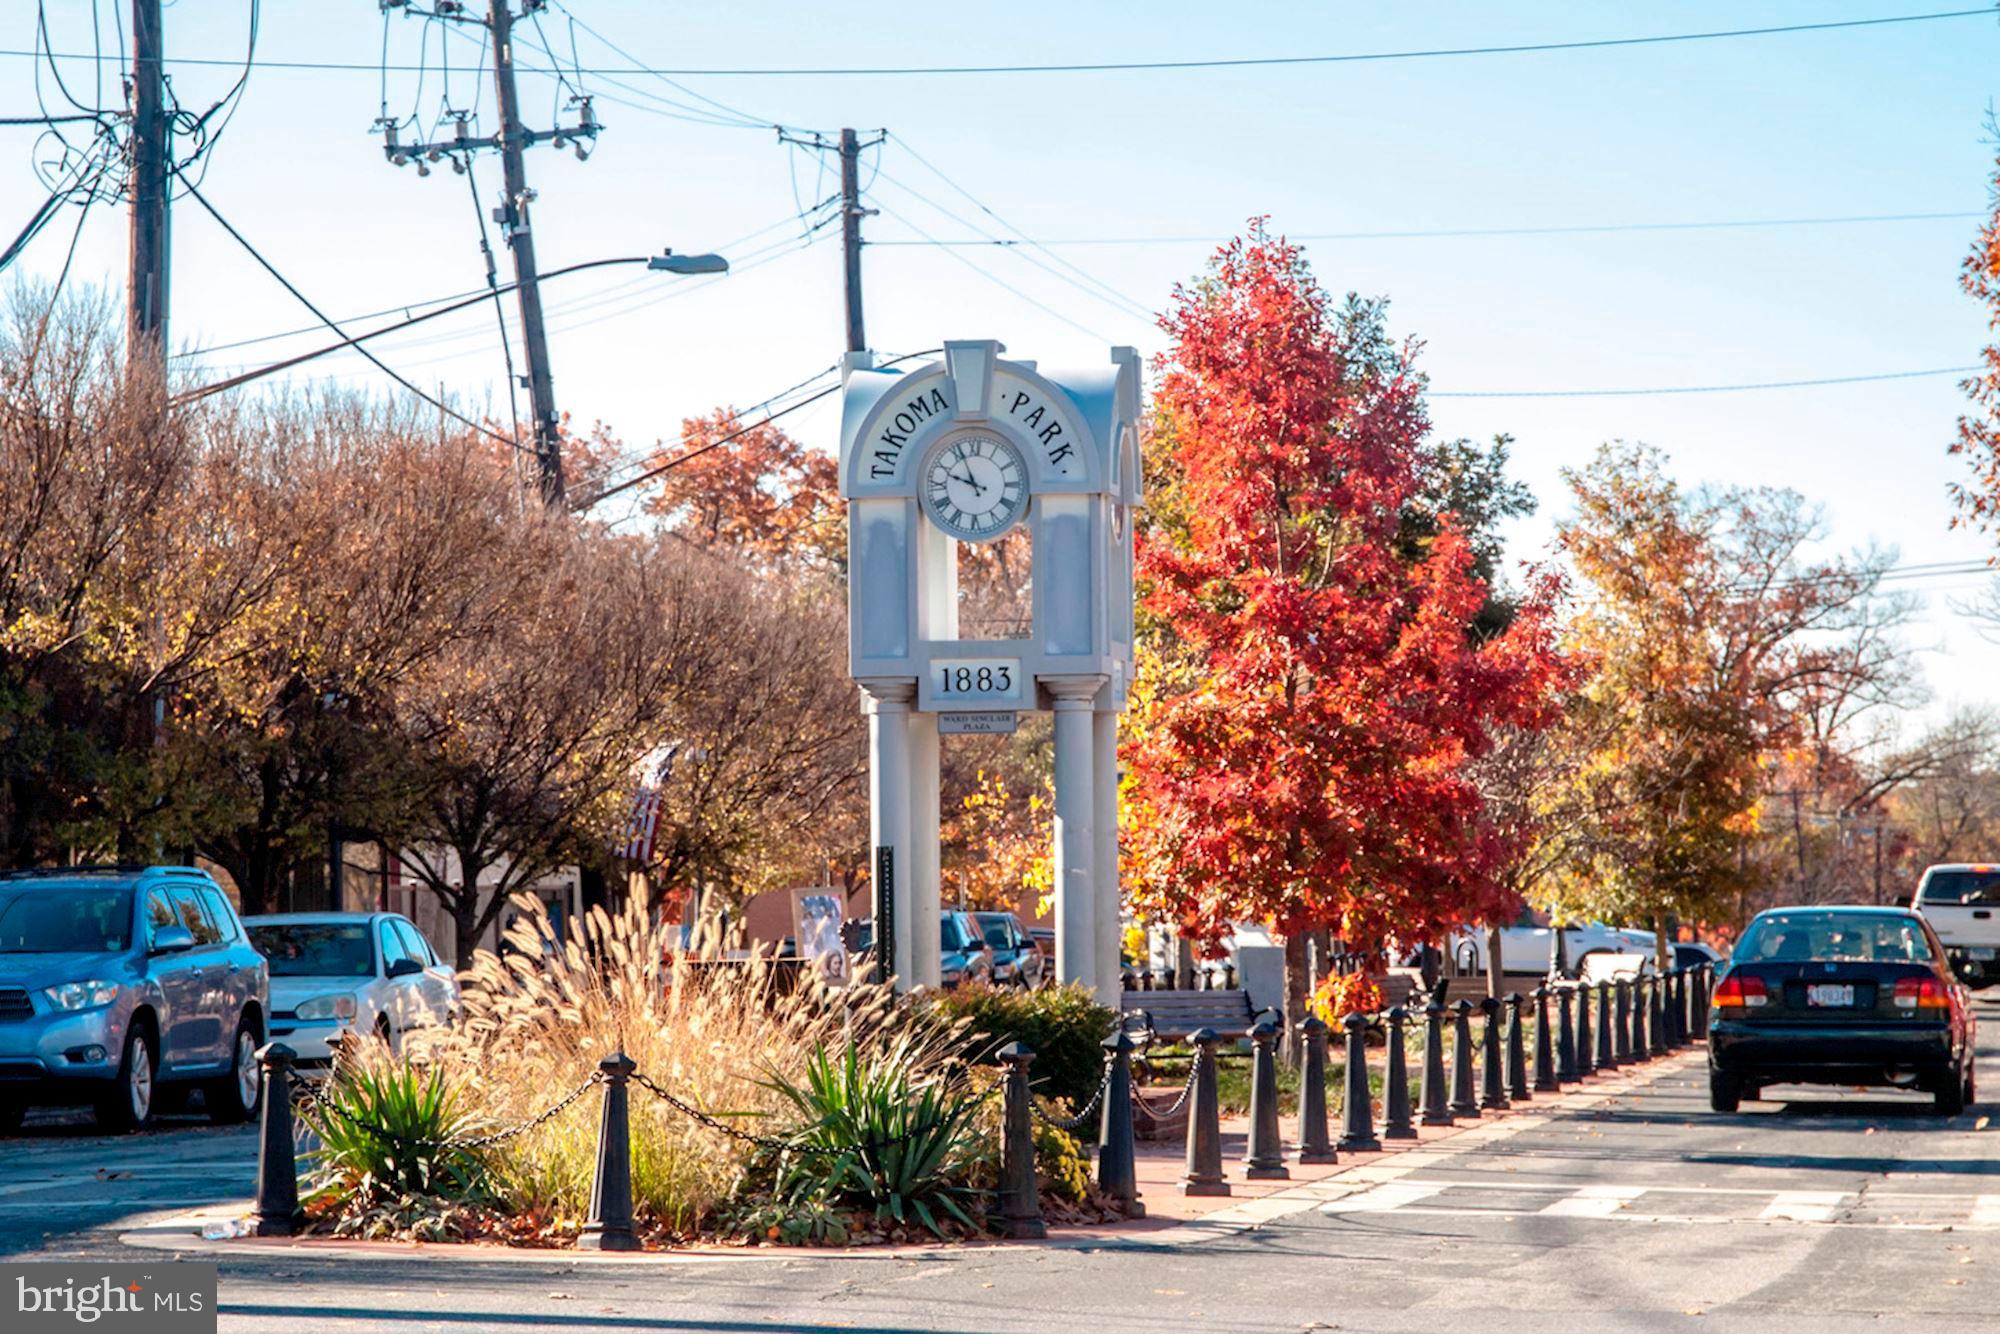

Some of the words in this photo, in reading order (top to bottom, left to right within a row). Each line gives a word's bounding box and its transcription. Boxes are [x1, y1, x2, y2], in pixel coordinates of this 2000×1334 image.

[871, 388, 950, 480] TAKOMA
[1009, 392, 1075, 466] PARK
[942, 666, 1012, 692] 1883
[943, 715, 969, 723] WARD
